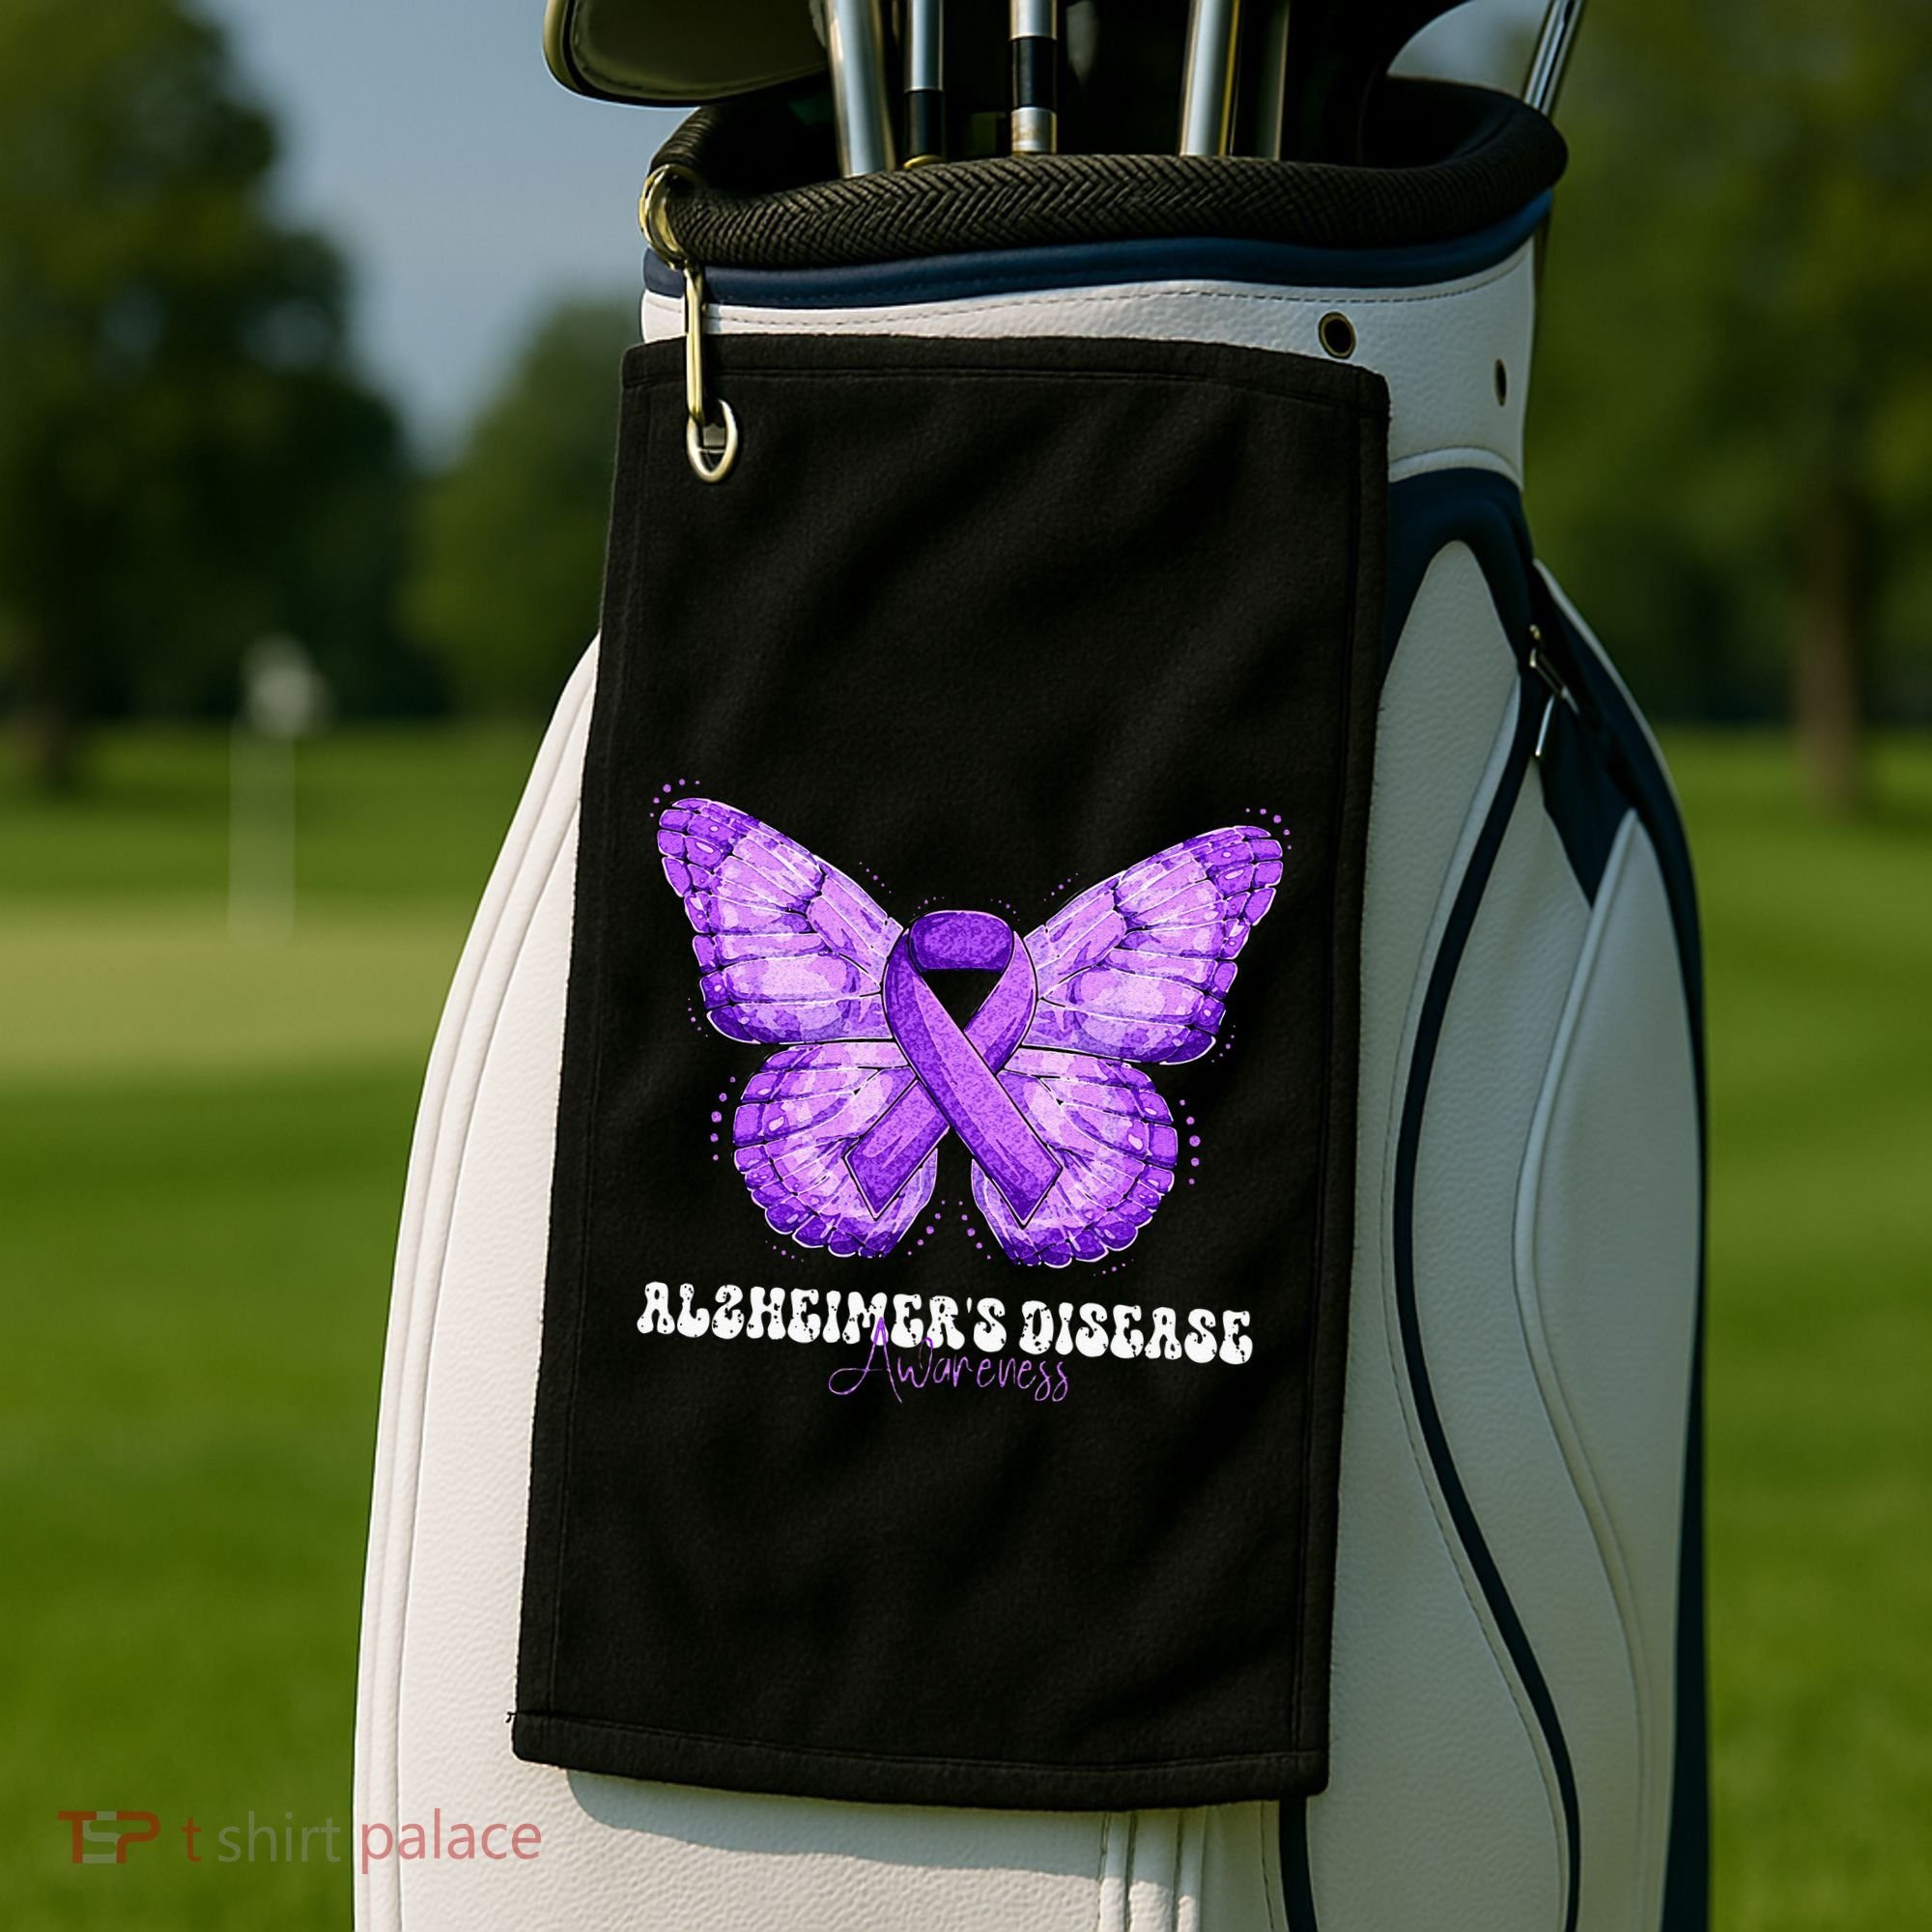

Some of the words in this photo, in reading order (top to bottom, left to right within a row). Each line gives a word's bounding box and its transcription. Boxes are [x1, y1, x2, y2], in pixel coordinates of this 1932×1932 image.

[637, 1281, 1007, 1352] ALZHEIMER'S
[1019, 1300, 1254, 1364] DISEASE
[828, 1317, 1070, 1404] Awareness
